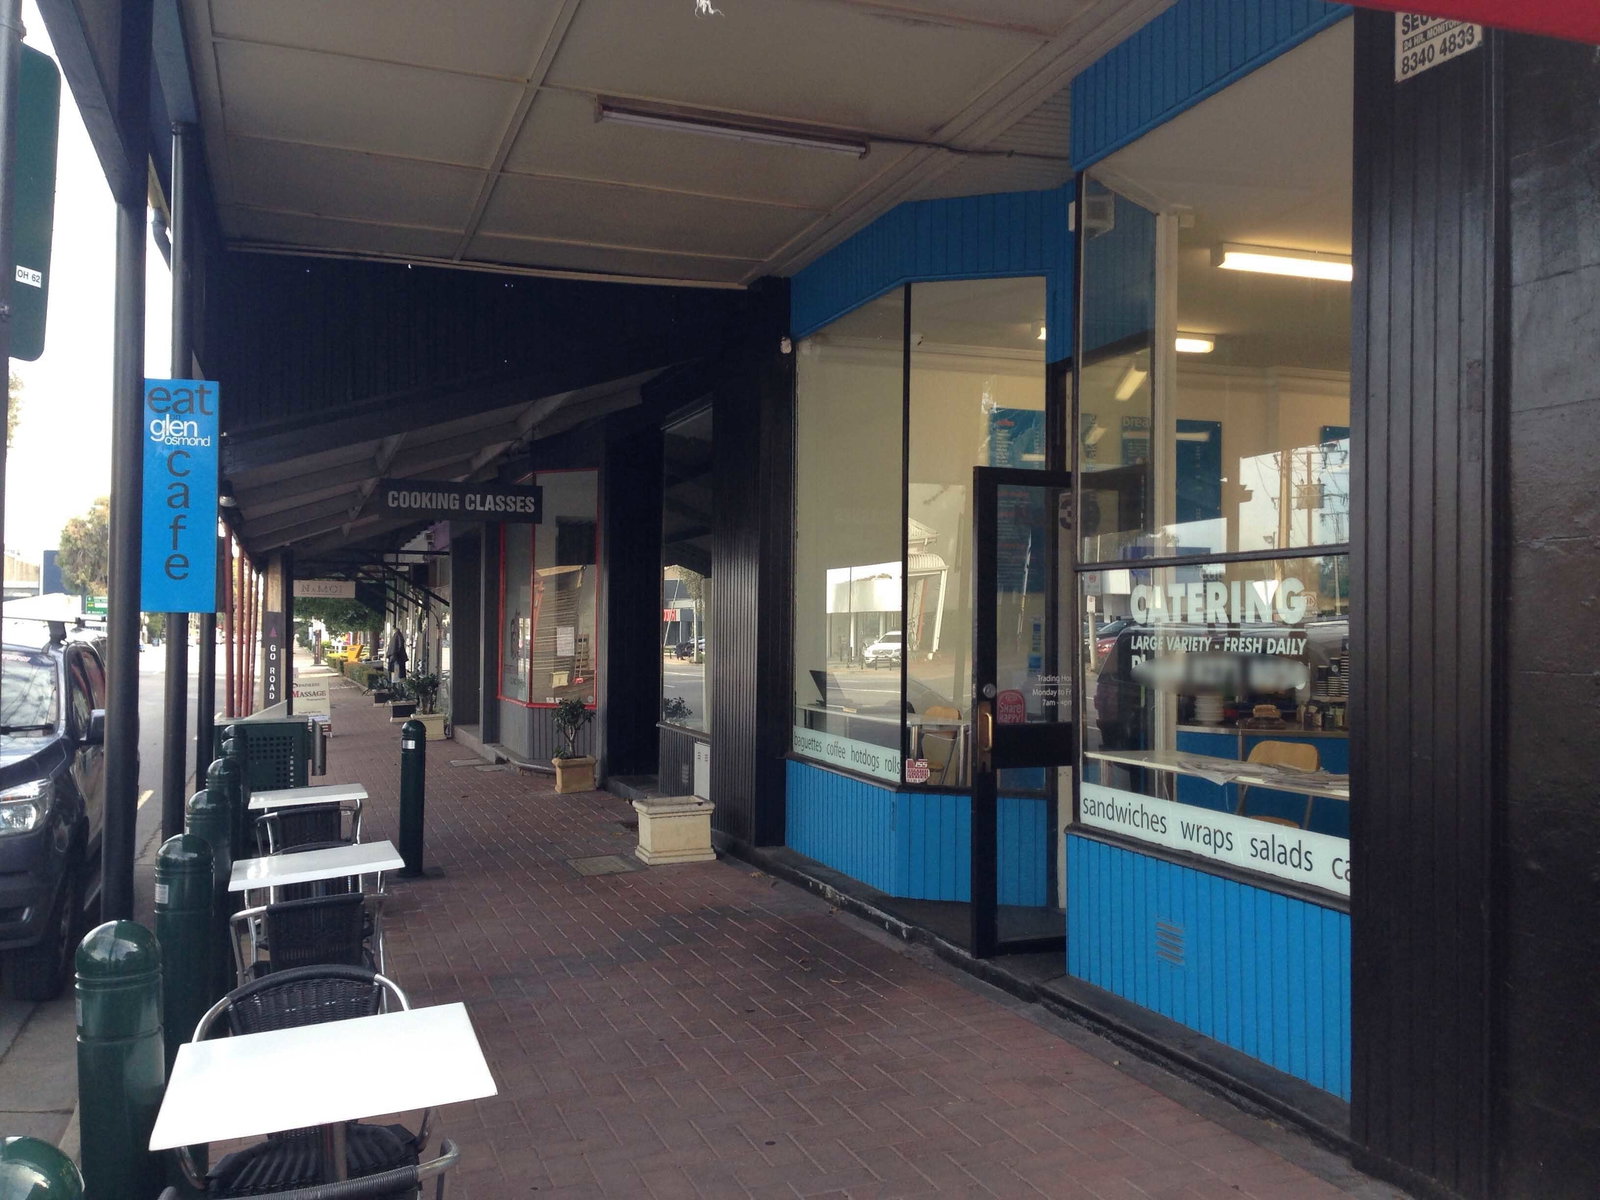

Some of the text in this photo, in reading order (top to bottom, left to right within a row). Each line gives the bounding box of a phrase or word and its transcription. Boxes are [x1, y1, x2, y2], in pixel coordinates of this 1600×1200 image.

[1401, 24, 1475, 75] 8340 4833
[17, 269, 41, 283] OH 62
[147, 384, 214, 416] eat
[149, 413, 198, 442] glen
[164, 435, 211, 447] osmond
[164, 449, 191, 581] cafe
[387, 490, 535, 513] COOKING CLASSES
[1130, 577, 1307, 625] CATERING
[1131, 635, 1163, 650] LARGE
[1166, 636, 1213, 652] VARIETY
[1224, 637, 1263, 653] FRESH
[1266, 638, 1308, 655] DAILY
[1032, 688, 1058, 697] Monday
[1037, 674, 1060, 684] Trading
[794, 731, 822, 753] baguettes
[826, 741, 846, 760] coffee
[850, 745, 880, 772] hotdogs
[884, 756, 901, 774] rolls
[1082, 796, 1167, 835] sandwiches
[1180, 820, 1234, 854] wraps
[1251, 834, 1314, 872] salads
